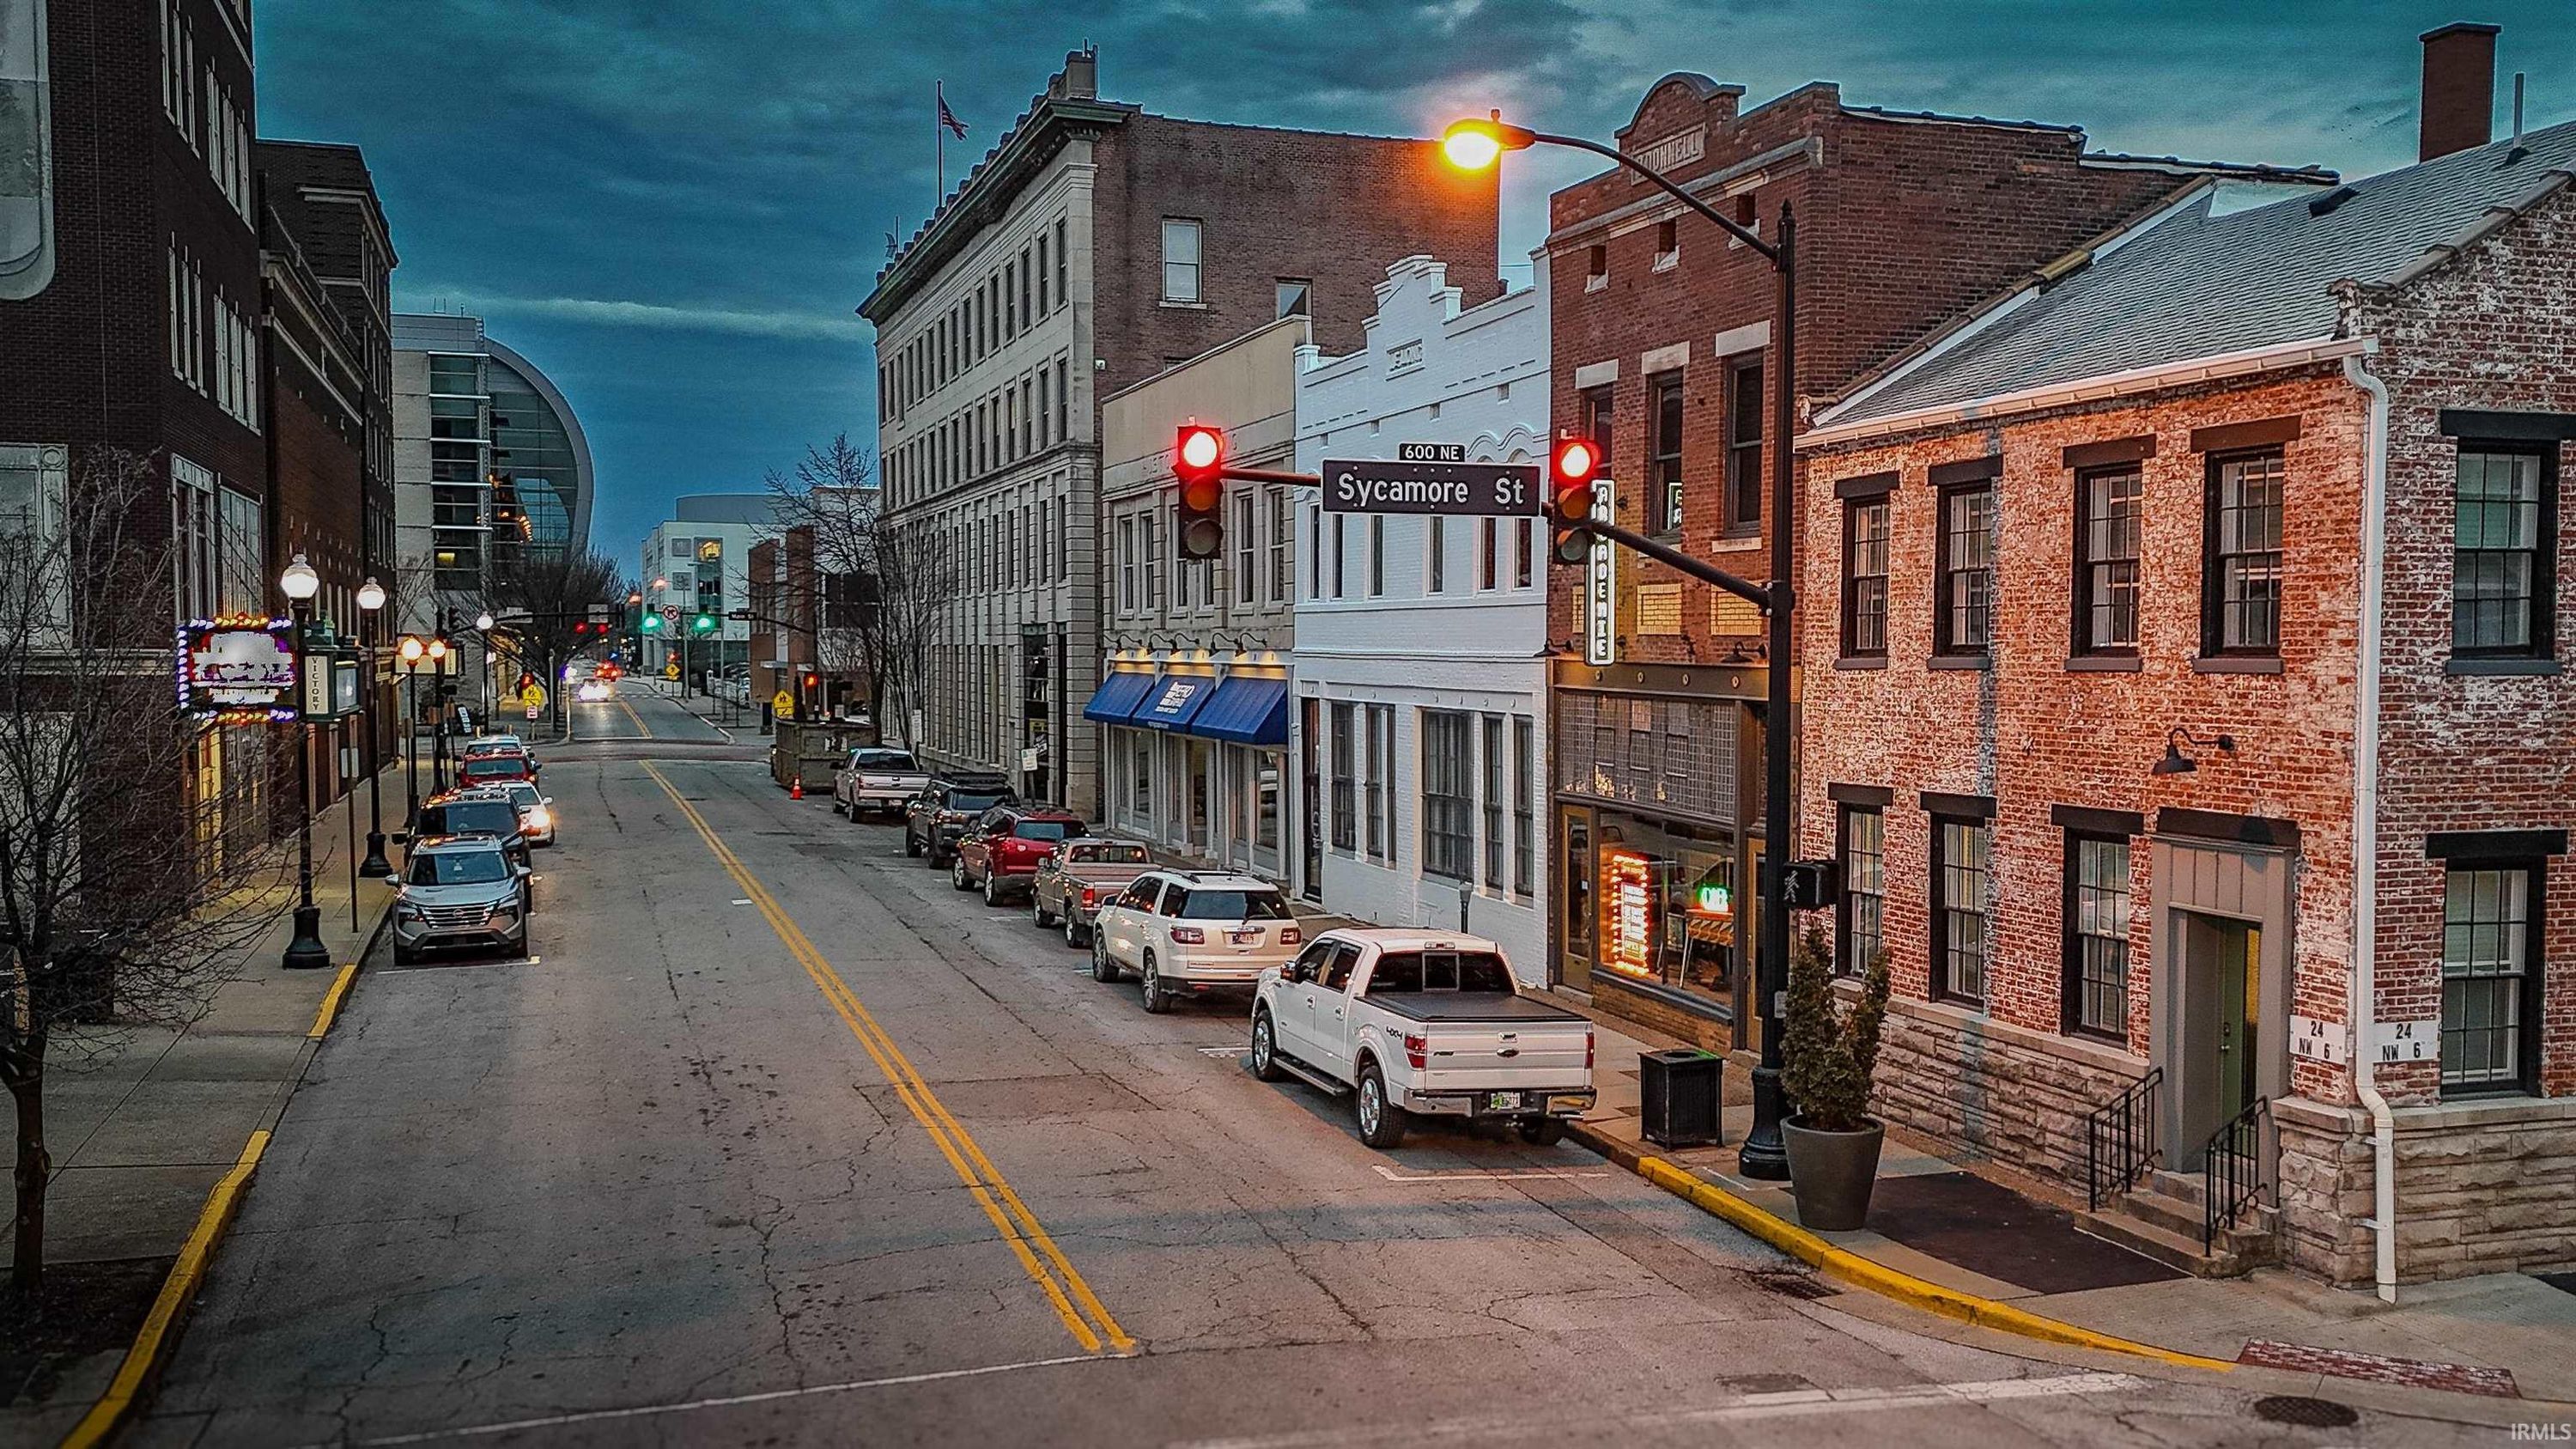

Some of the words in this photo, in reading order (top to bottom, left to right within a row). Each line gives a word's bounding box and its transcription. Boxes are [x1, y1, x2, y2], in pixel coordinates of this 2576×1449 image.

[1405, 445, 1434, 460] 600
[1440, 446, 1460, 460] NE
[1338, 472, 1468, 507] Sycamore
[1494, 478, 1524, 505] St
[311, 657, 319, 710] VICTORY
[2310, 1020, 2324, 1038] 24
[2396, 1023, 2412, 1039] 24
[2299, 1038, 2312, 1056] NW
[2324, 1043, 2330, 1059] 6
[2382, 1044, 2399, 1061] NW
[2413, 1042, 2421, 1058] 6
